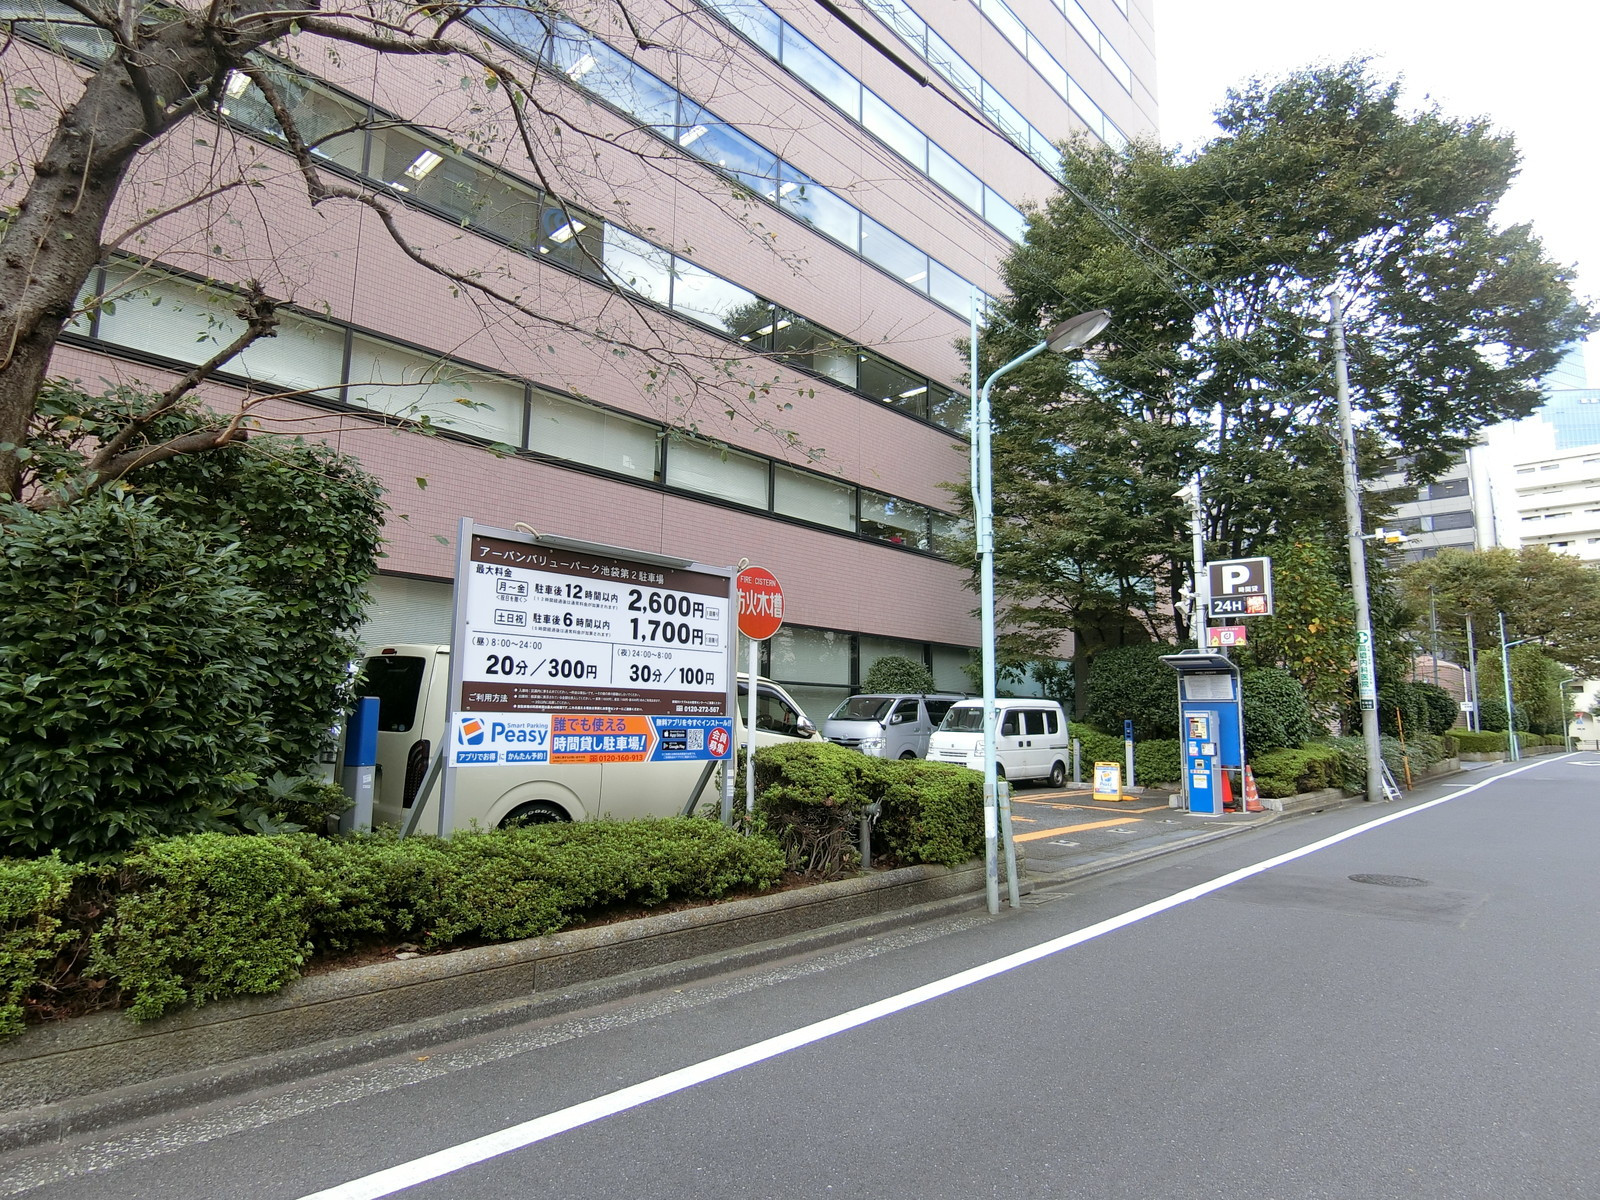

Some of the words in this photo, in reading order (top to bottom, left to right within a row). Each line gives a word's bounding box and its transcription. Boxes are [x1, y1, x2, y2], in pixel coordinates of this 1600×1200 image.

[475, 563, 513, 578] 最大料金
[740, 575, 752, 584] FIRE
[755, 577, 777, 587] CISTERN
[1222, 564, 1250, 595] P
[628, 588, 704, 619] 2,600円
[1214, 600, 1242, 613] 24H
[497, 612, 524, 625] 土日祝
[630, 617, 704, 646] 1,700円
[468, 692, 509, 703] ご利用方法
[553, 717, 626, 732] 誰でも使える
[491, 722, 549, 746] Peasy
[458, 751, 496, 762] アプリでお得
